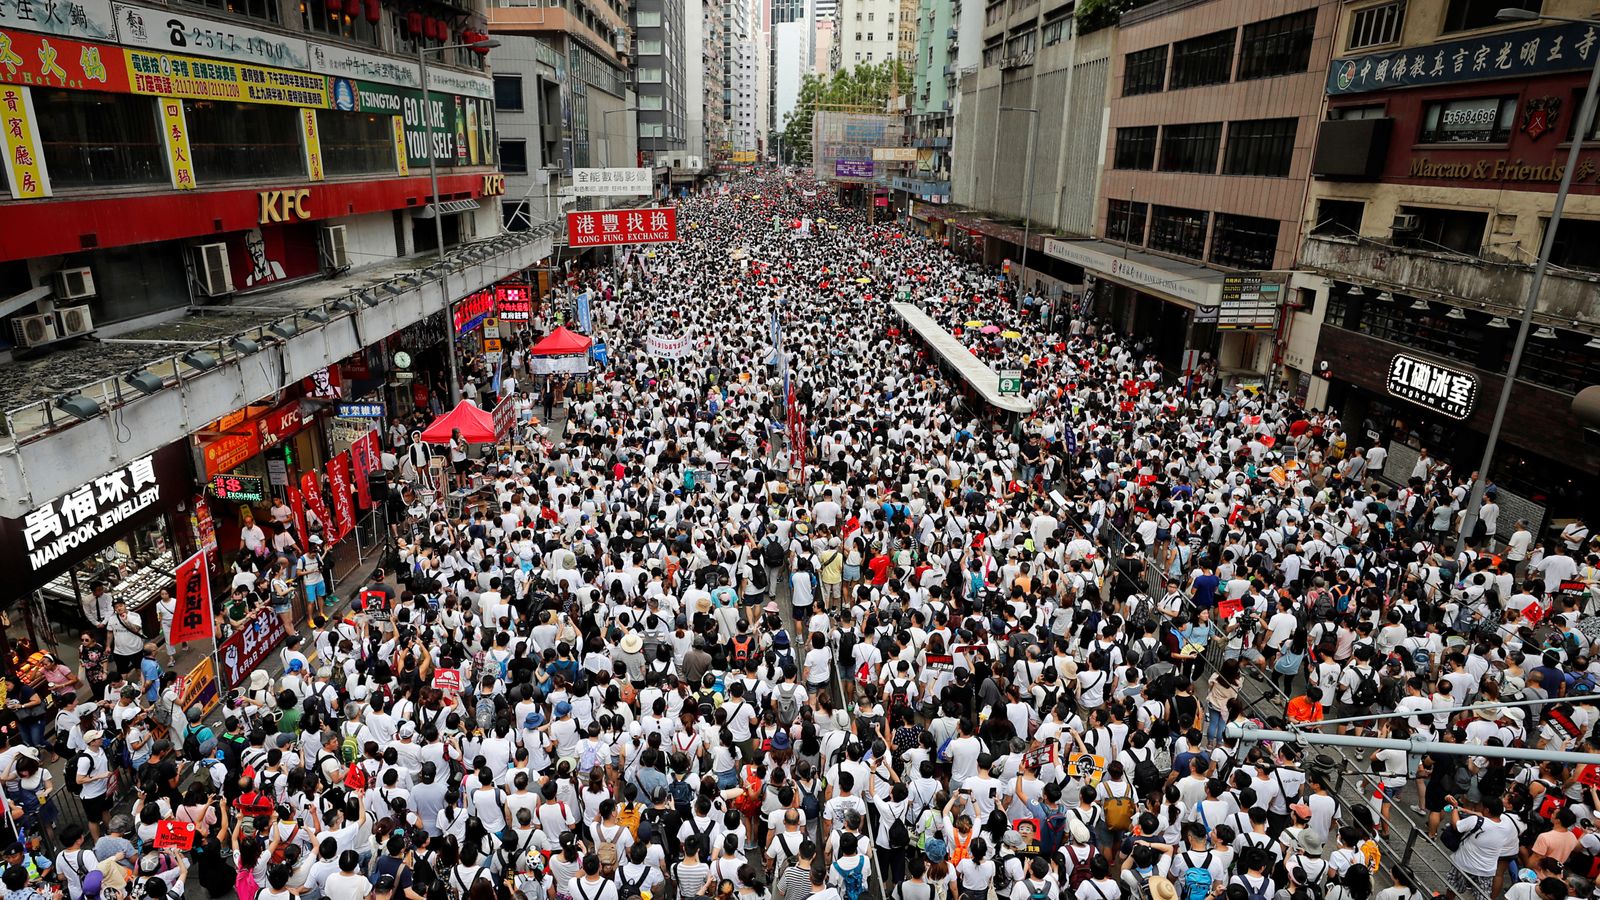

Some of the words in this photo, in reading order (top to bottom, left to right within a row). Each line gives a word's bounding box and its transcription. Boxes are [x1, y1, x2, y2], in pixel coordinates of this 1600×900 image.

[193, 27, 235, 51] 2577
[247, 41, 284, 60] 4400
[1360, 27, 1598, 85] 中國佛教真言宗光明王寺
[359, 91, 400, 110] TSINGTAO
[403, 98, 418, 125] GO
[422, 99, 445, 128] ARE
[3, 90, 37, 193] 貴賓廳房
[166, 104, 191, 184] 四季火鍋
[406, 131, 453, 158] YOUSELF
[1409, 157, 1473, 179] Marcato
[1473, 159, 1490, 179] &
[1492, 158, 1564, 182] Friends
[483, 175, 505, 195] KFC
[260, 189, 311, 224] KFC
[576, 211, 668, 234] 港豐找換
[577, 235, 599, 244] KONG
[603, 233, 624, 242] FUNG
[628, 231, 669, 241] EXCHANGE
[1389, 382, 1435, 404] hunghom
[1441, 402, 1466, 416] café
[281, 409, 299, 431] KFC
[227, 491, 260, 501] EXCHANGE
[30, 524, 97, 571] MANFOOK
[97, 484, 160, 533] JEWELLERY
